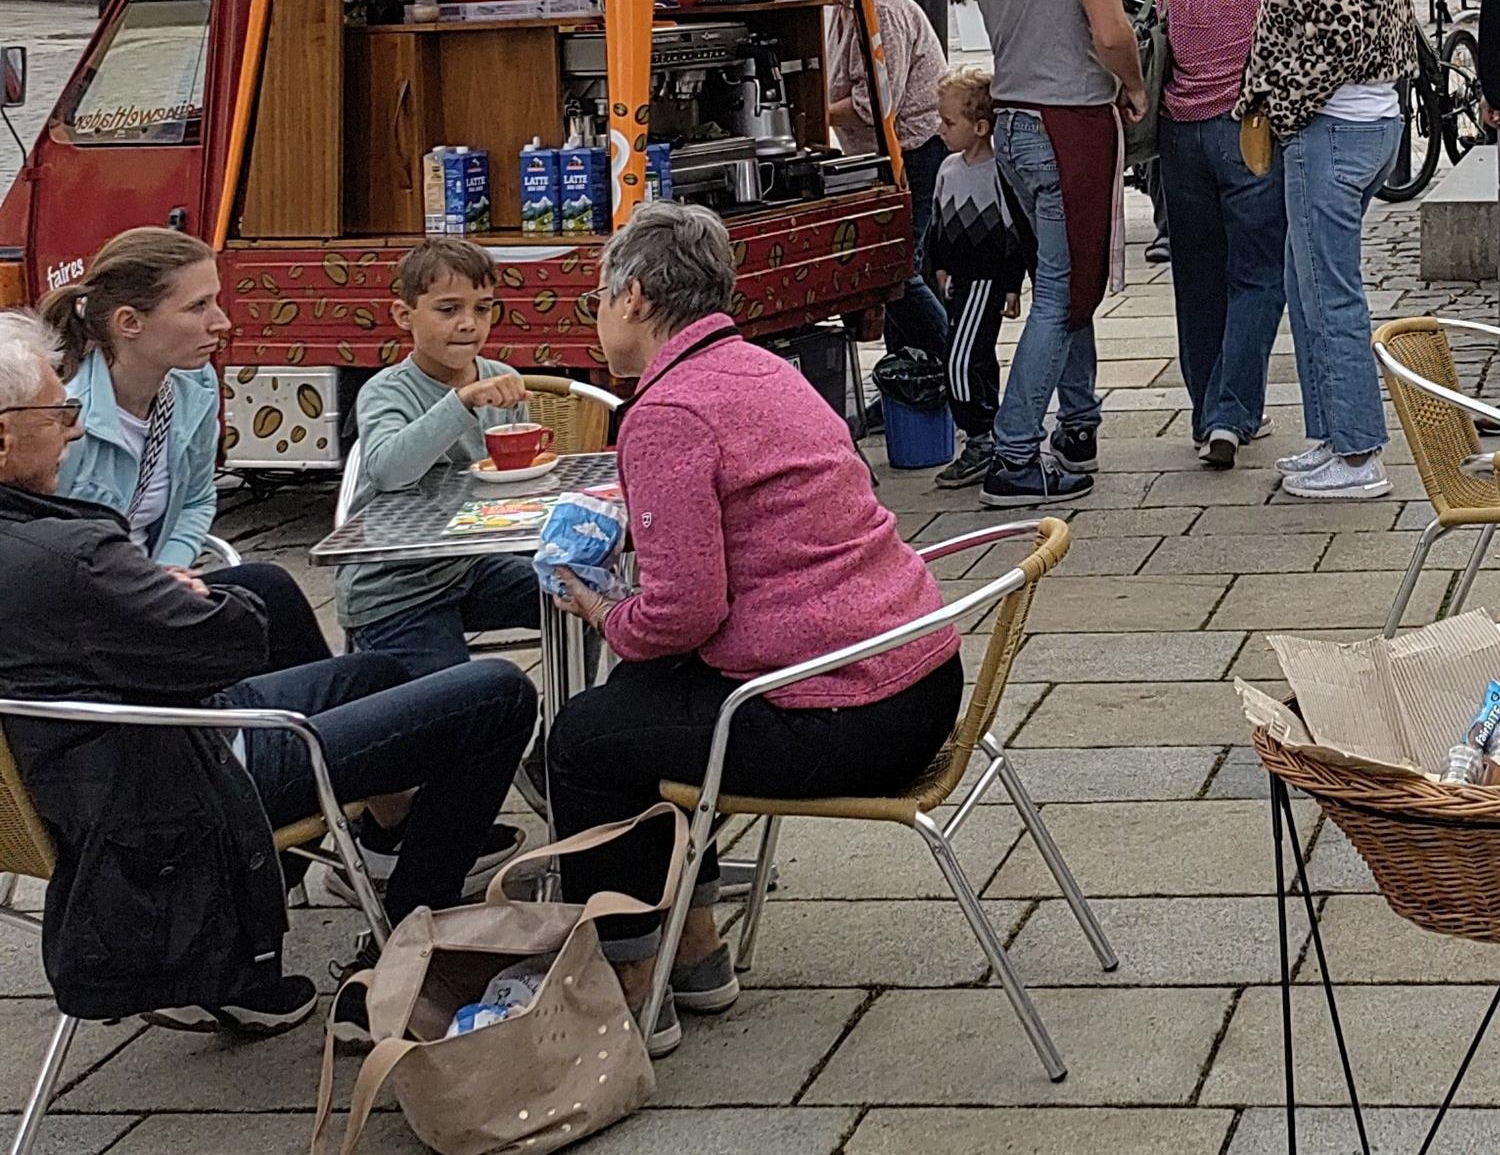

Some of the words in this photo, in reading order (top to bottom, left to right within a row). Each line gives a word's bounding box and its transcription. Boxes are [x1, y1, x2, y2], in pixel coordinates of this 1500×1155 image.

[465, 176, 486, 187] LATTE
[524, 176, 549, 186] LATTE
[563, 175, 588, 184] LATTE
[47, 258, 85, 291] faires
